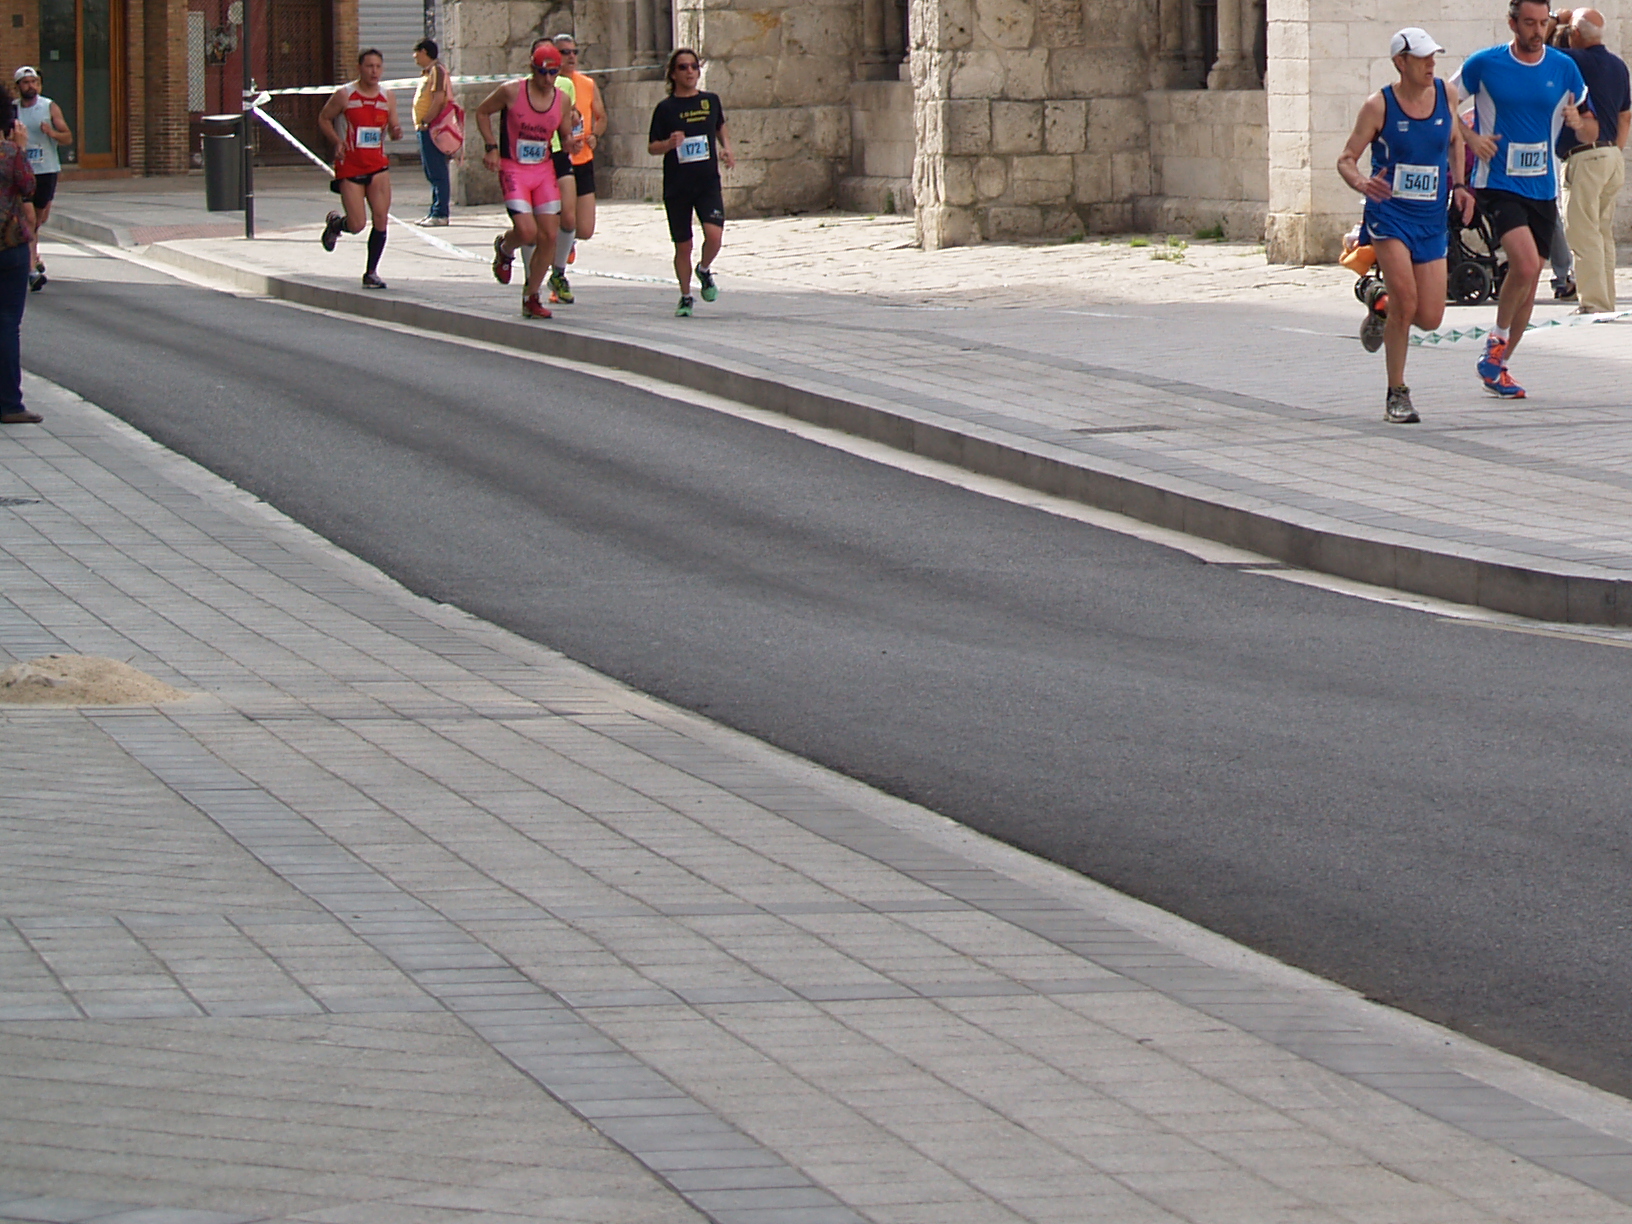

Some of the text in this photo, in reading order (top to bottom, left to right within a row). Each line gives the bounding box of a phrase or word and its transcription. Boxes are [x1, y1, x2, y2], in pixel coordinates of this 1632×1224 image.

[685, 142, 701, 155] 172
[1520, 152, 1540, 167] 102
[1405, 174, 1429, 191] 540
